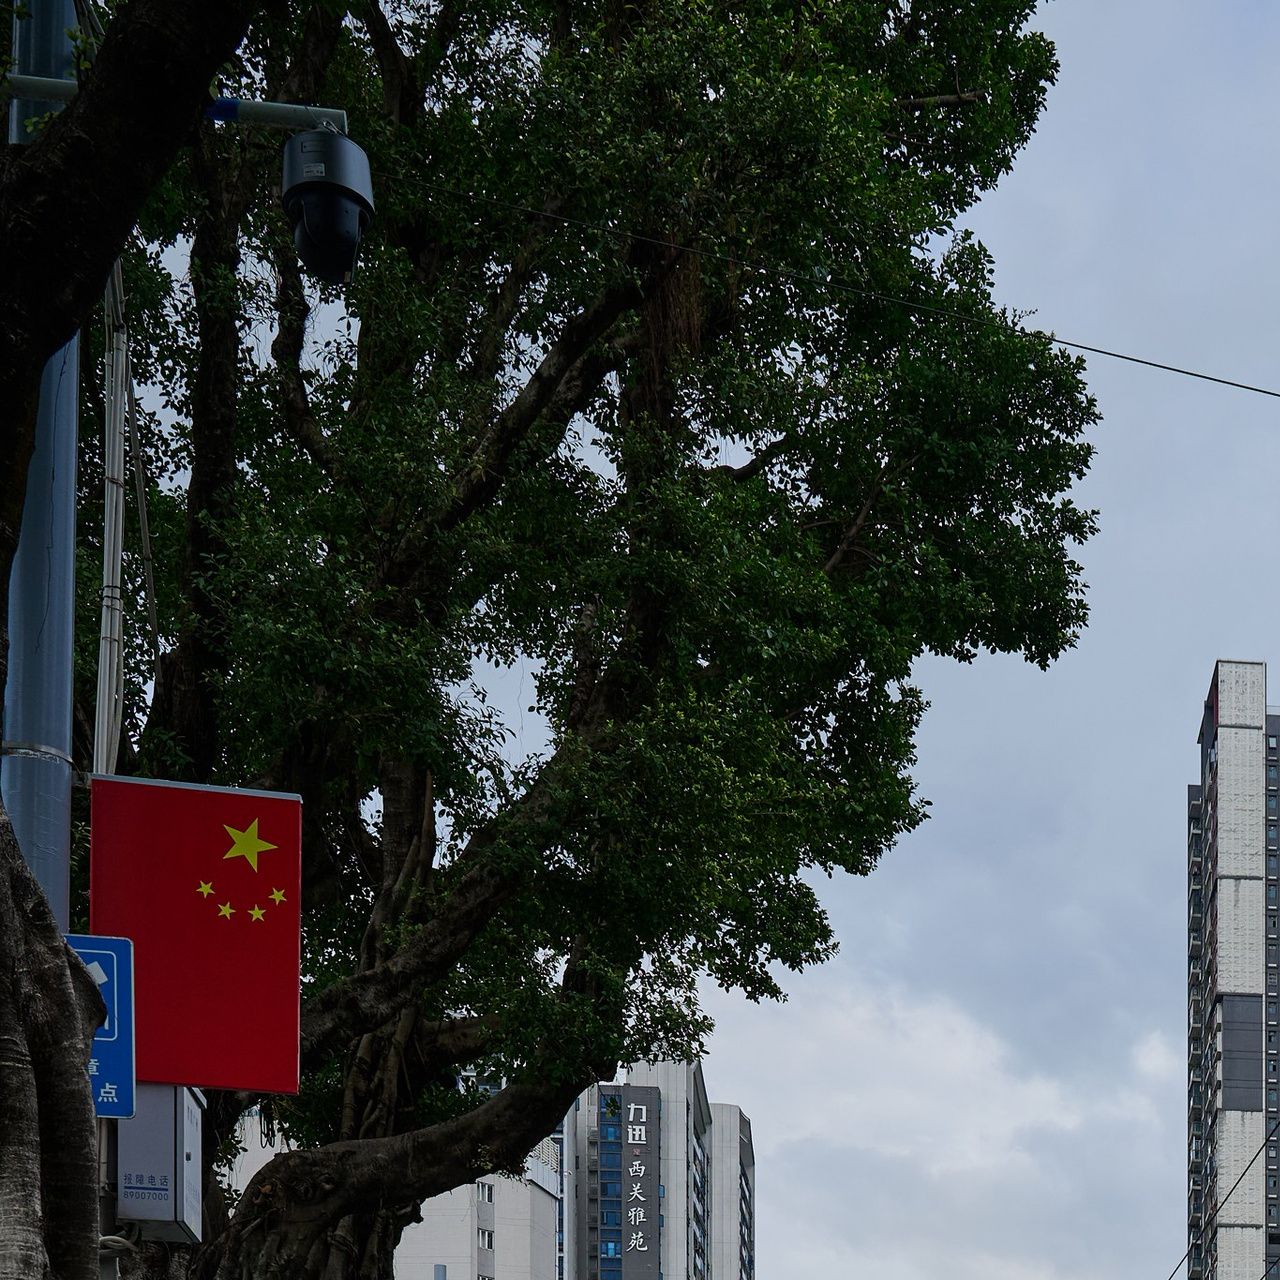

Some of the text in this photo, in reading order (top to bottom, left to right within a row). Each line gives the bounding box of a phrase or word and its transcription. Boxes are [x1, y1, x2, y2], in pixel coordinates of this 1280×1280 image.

[97, 1082, 119, 1103] 点
[123, 1173, 170, 1187] 报障电话
[626, 1102, 649, 1252] 力迅 西关雅苑
[123, 1190, 170, 1201] 89007000
